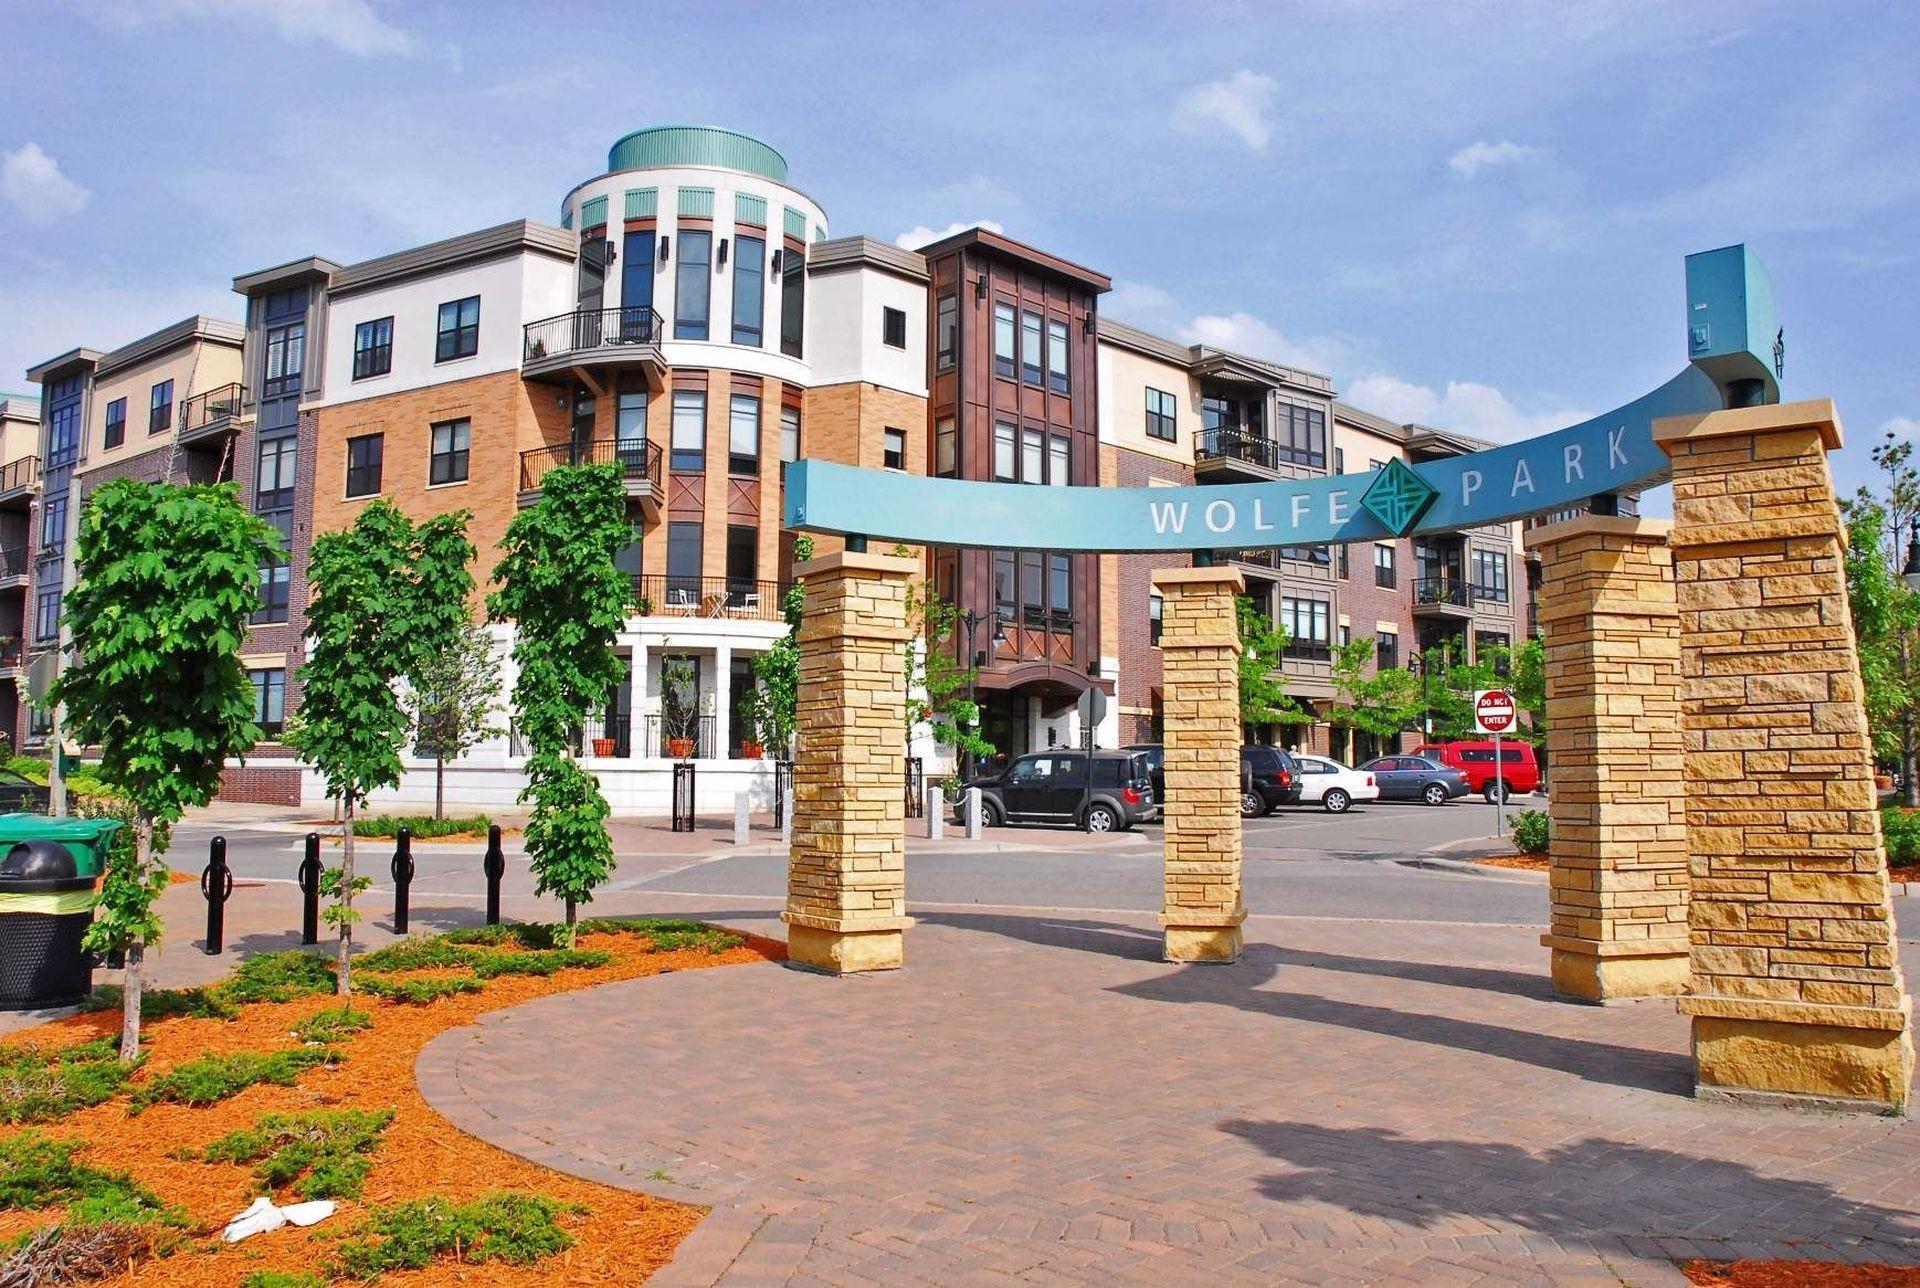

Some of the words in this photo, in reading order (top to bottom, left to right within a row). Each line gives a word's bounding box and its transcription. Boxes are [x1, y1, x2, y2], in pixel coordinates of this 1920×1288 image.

[1149, 490, 1350, 534] WOLFE
[1462, 425, 1629, 506] PARK
[1481, 698, 1492, 706] DO
[1484, 716, 1507, 725] ENTER
